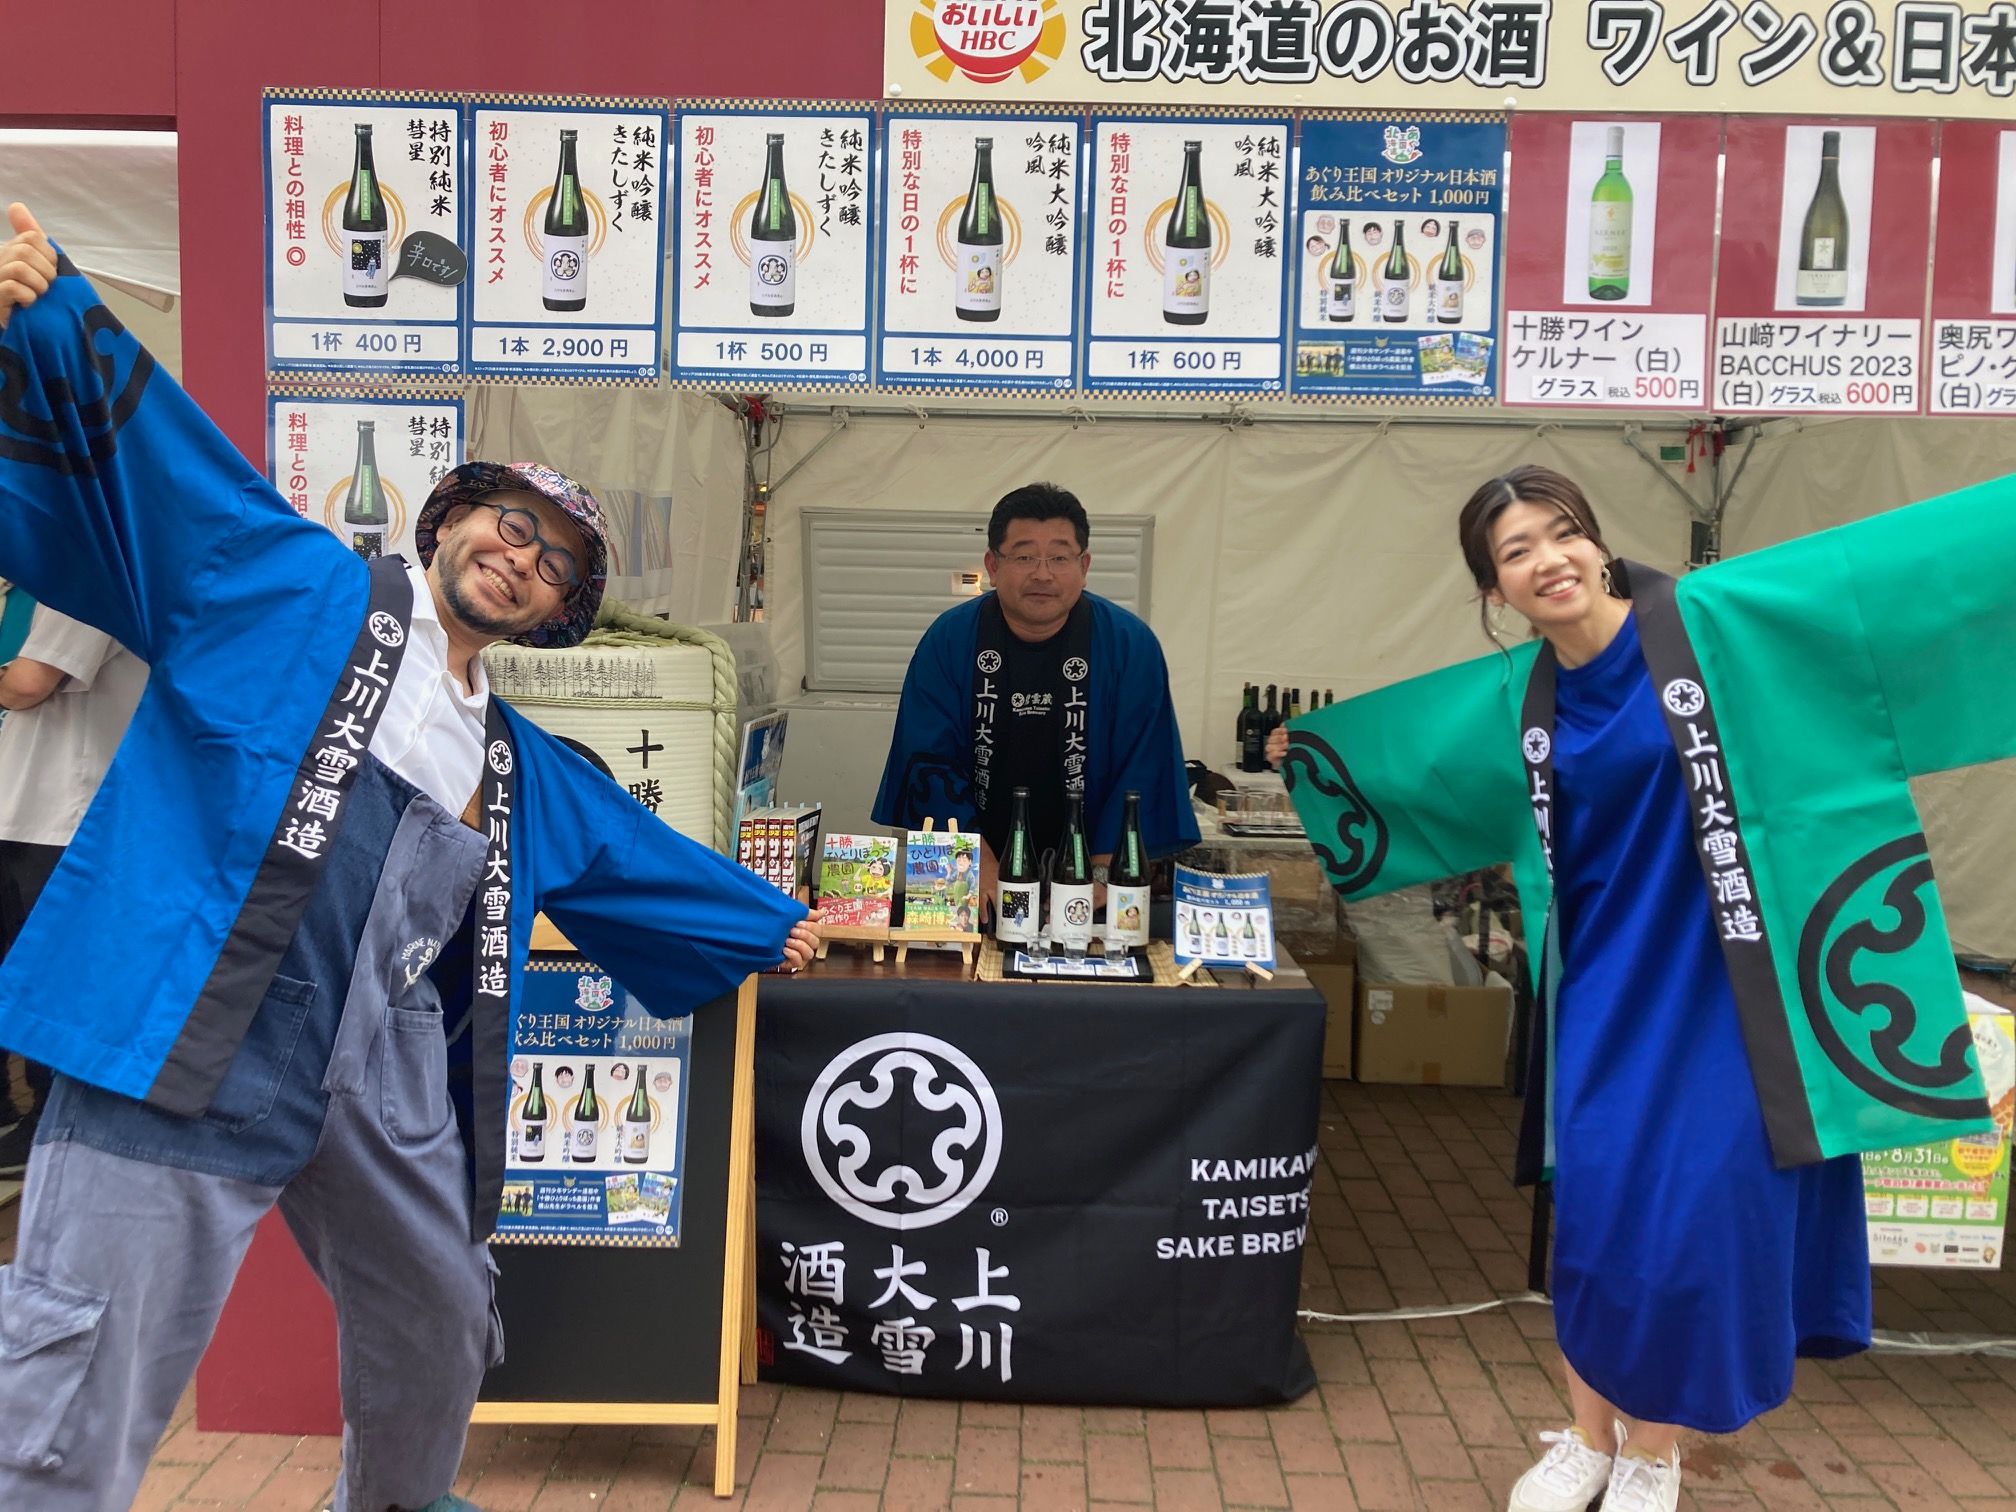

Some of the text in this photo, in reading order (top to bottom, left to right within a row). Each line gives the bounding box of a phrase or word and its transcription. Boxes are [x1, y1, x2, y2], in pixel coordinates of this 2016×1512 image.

[942, 3, 1038, 26] おいしい
[960, 30, 1017, 50] HBC
[1084, 0, 1545, 86] 北海道のお酒
[429, 120, 452, 217] 特別純米
[630, 126, 656, 222] 純米吟醸
[1025, 132, 1047, 175] 吟風
[1233, 139, 1256, 178] 吟風
[608, 124, 630, 233] きたしずく
[816, 128, 838, 237] きたしずく
[838, 129, 863, 227] 純米吟醸
[1045, 135, 1072, 256] 純米大吟醸
[1305, 166, 1497, 186] あぐり王国 オリジナル日本酒
[1310, 185, 1489, 205] 飲み比べセット 1,000円
[488, 121, 509, 285] 初心者にオススメ
[694, 126, 715, 289] 初心者にオススメ
[899, 130, 922, 295] 特別な日の1杯に
[1107, 133, 1131, 298] 特別な日の1杯に
[1254, 137, 1281, 259] 純米大吟醸
[311, 332, 343, 352] 1杯
[499, 337, 530, 357] 1本
[1512, 316, 1644, 341] 十勝ワイン
[1939, 324, 2016, 349] 奥尻ワ
[716, 341, 747, 360] 1杯
[911, 346, 942, 366] 1本
[1127, 349, 1159, 369] 1杯
[1720, 355, 1912, 376] BACCHUS 2023
[1538, 378, 1598, 397] グラス
[1608, 387, 1630, 398] 税込
[1770, 385, 1817, 404] グラス
[288, 412, 309, 520] 料理との相
[277, 648, 390, 860] 上川大雪酒造
[1064, 686, 1088, 791] 上川大雪酒
[626, 729, 664, 814] 十勝
[826, 836, 853, 849] 十勝
[826, 846, 890, 859] ひとりぼっち
[909, 833, 936, 845] 十勝
[1684, 723, 1762, 943] 上川大雪酒造
[478, 782, 511, 997] 上川大雪酒造
[574, 1015, 683, 1031] オリジナル日本酒
[620, 1035, 676, 1050] 1,000円
[1201, 1186, 1311, 1220] TAISETS
[1156, 1234, 1235, 1260] SAKE
[780, 1240, 854, 1366] 酒造
[868, 1243, 937, 1376] 大雪
[951, 1247, 1022, 1384] 上川
